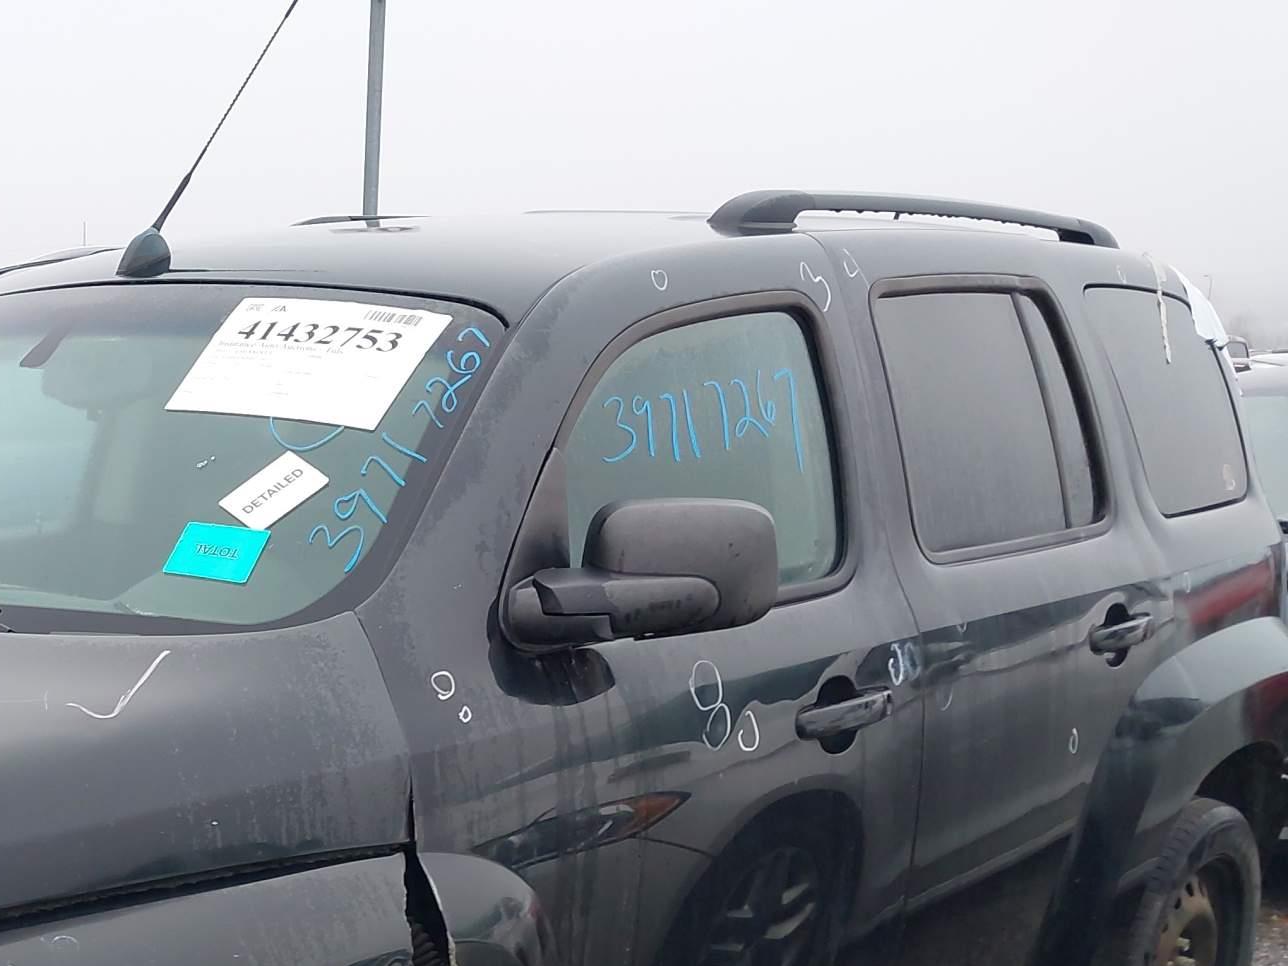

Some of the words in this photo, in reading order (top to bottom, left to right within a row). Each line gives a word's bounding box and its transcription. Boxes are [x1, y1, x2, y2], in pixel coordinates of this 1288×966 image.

[238, 319, 404, 353] 41432753
[242, 468, 304, 514] DETAILED
[196, 543, 239, 559] TOTAL
